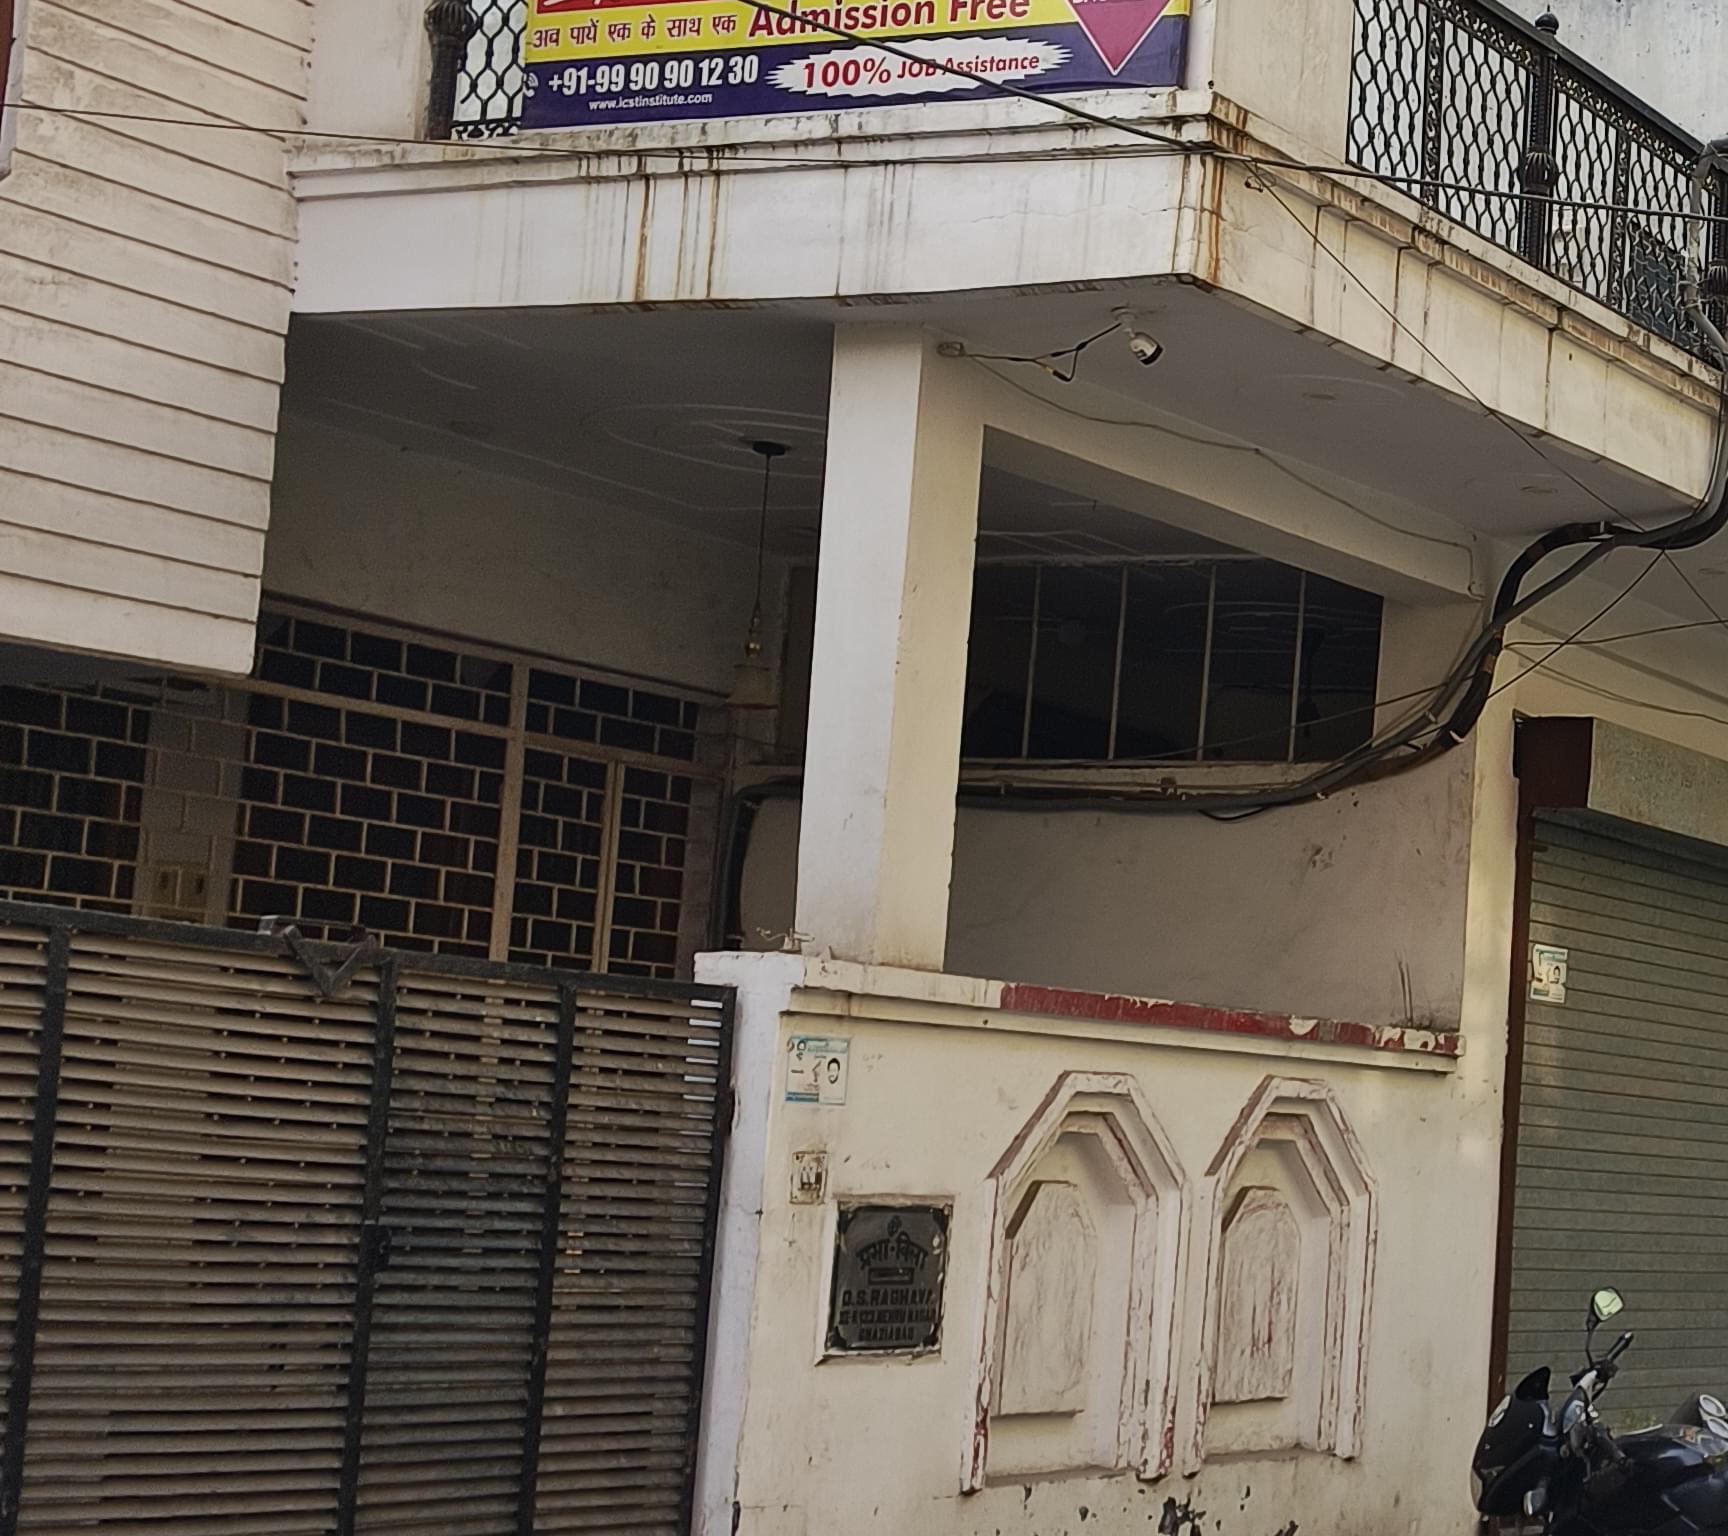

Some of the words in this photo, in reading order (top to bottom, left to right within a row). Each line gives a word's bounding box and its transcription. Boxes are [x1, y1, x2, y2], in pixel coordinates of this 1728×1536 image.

[607, 22, 632, 43] एक
[640, 14, 656, 41] के
[666, 16, 703, 39] साथ
[711, 13, 738, 37] एक
[628, 61, 660, 91] 90
[663, 58, 695, 89] 90
[698, 57, 724, 86] 12
[727, 54, 759, 83] 30
[803, 56, 892, 90] 100%
[896, 59, 937, 81] JOB
[942, 53, 1040, 77] Assistance
[588, 92, 714, 112] www.icstinstitute.com
